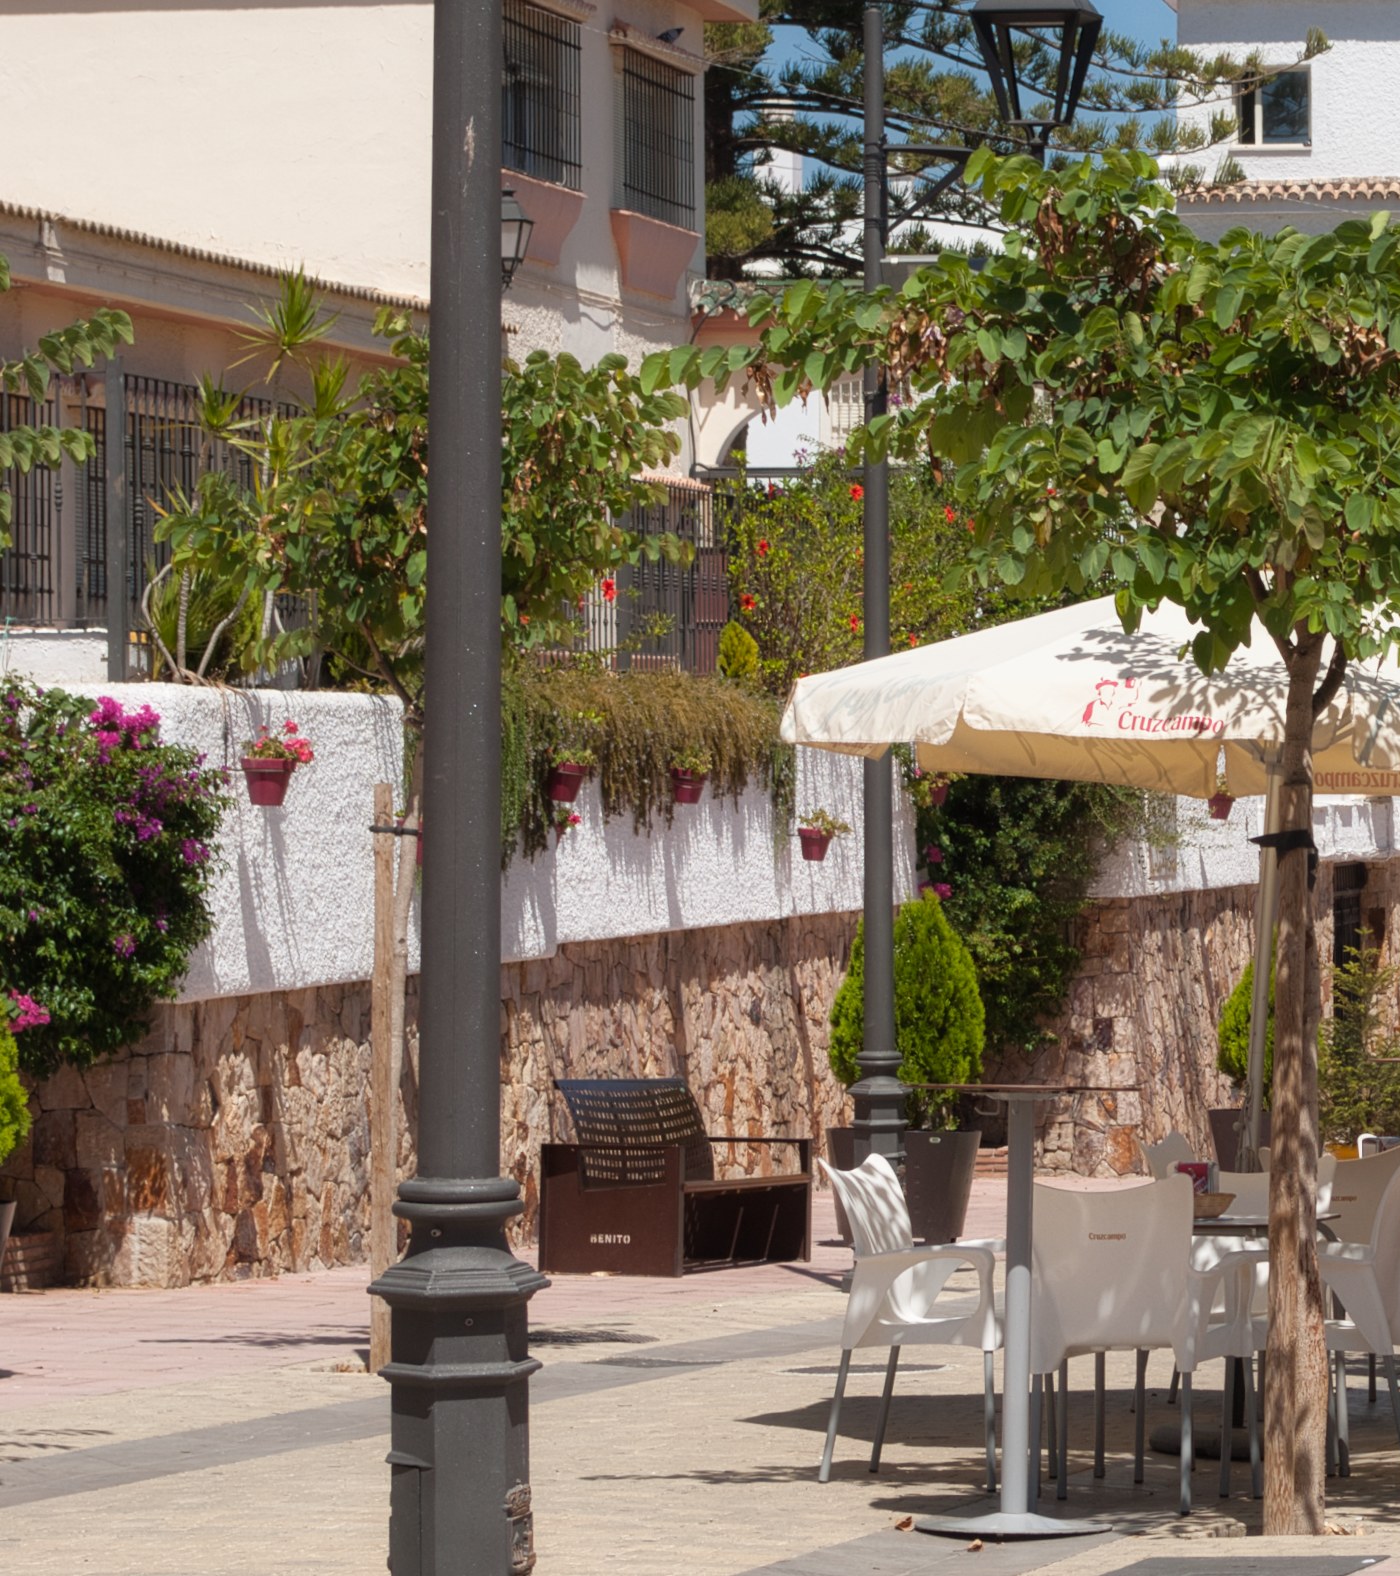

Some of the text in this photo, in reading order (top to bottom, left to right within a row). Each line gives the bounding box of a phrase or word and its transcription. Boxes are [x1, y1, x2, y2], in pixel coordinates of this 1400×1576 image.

[1118, 710, 1225, 734] Cruzcampo
[590, 1233, 631, 1244] BENITO
[1088, 1232, 1127, 1241] Cruzcampo
